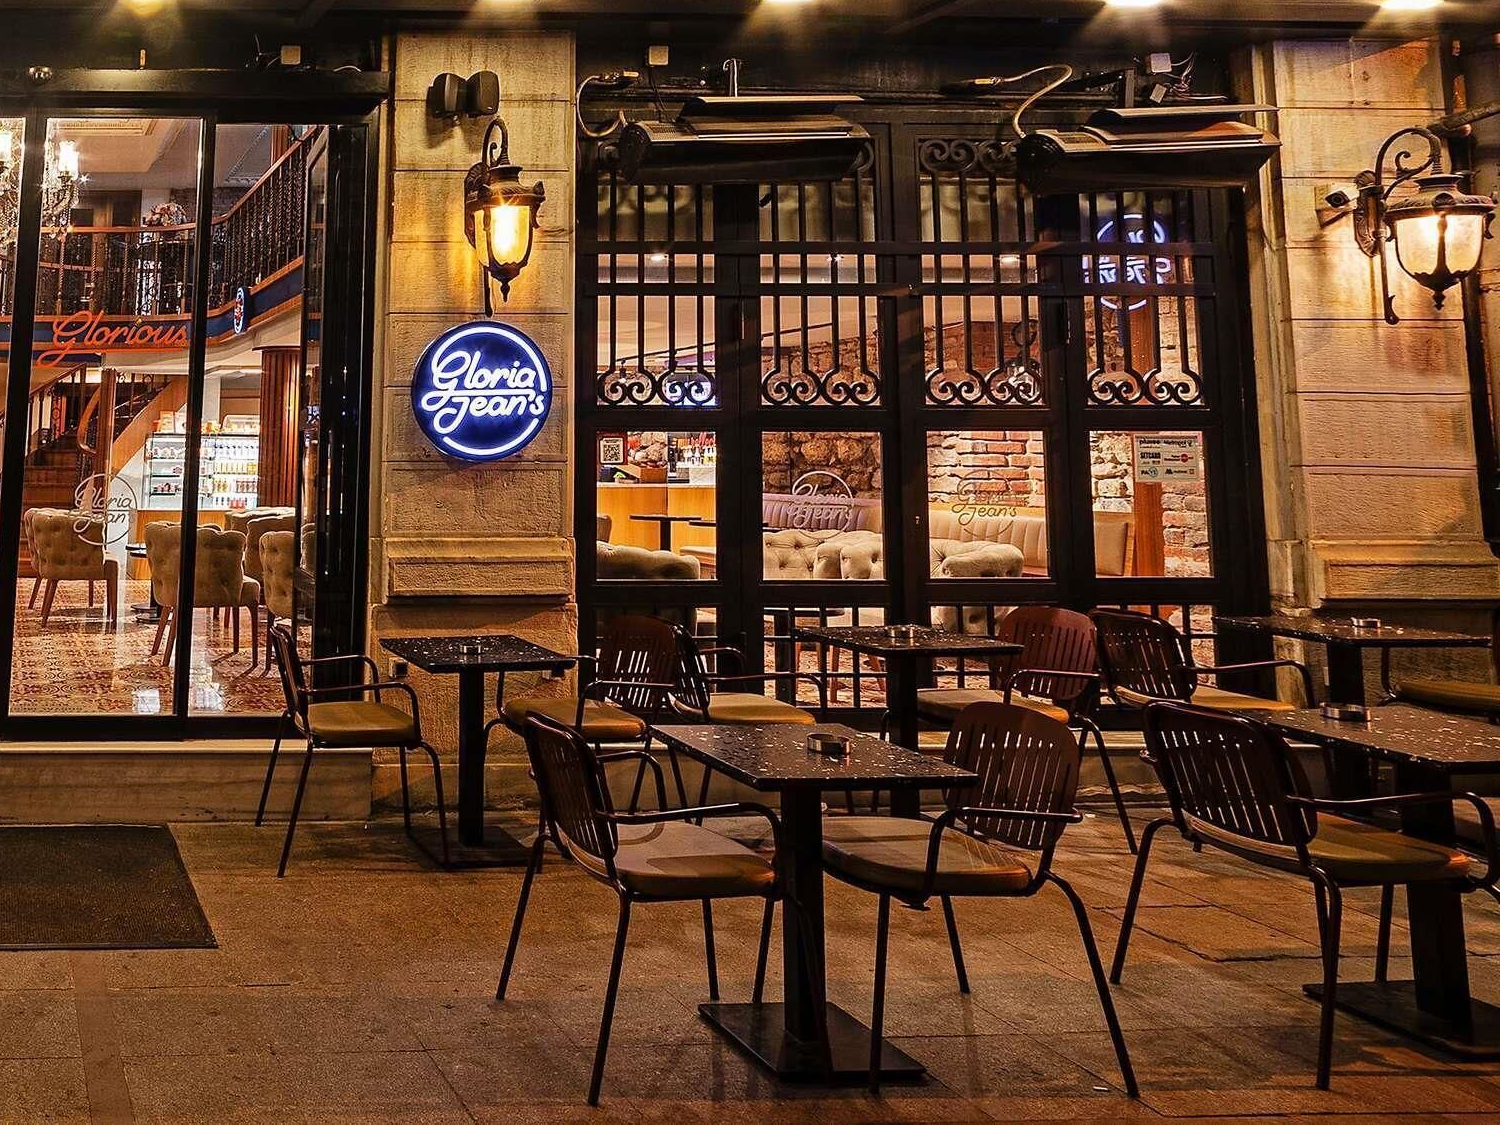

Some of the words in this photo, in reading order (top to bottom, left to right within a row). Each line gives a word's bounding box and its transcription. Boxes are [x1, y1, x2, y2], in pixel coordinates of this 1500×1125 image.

[36, 309, 188, 368] Glorious
[422, 350, 537, 411] Gloria
[434, 394, 545, 434] Jean's
[958, 506, 1017, 525] Jean's
